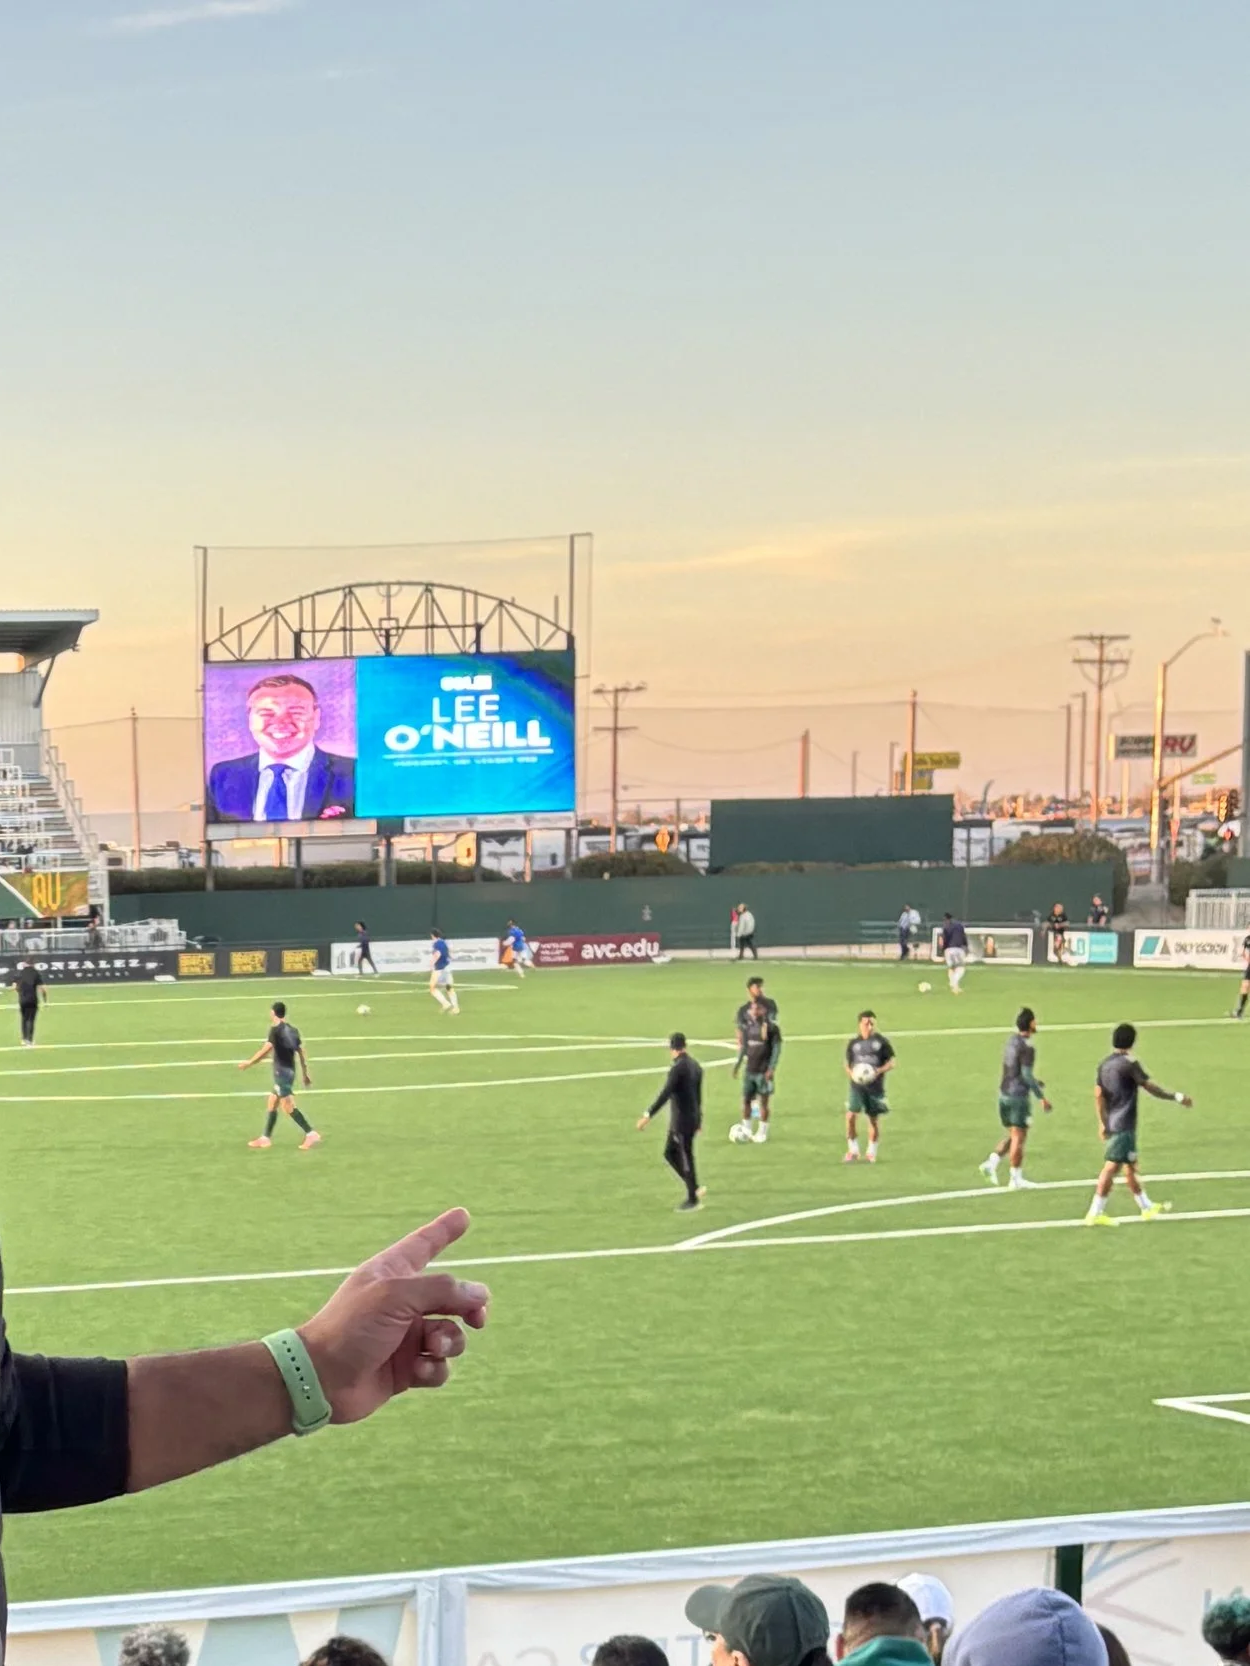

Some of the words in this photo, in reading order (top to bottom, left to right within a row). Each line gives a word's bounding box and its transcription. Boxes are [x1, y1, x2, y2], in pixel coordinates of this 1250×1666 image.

[432, 694, 500, 723] LEE
[383, 719, 551, 751] O'NEILL
[581, 937, 660, 960] avc.edu
